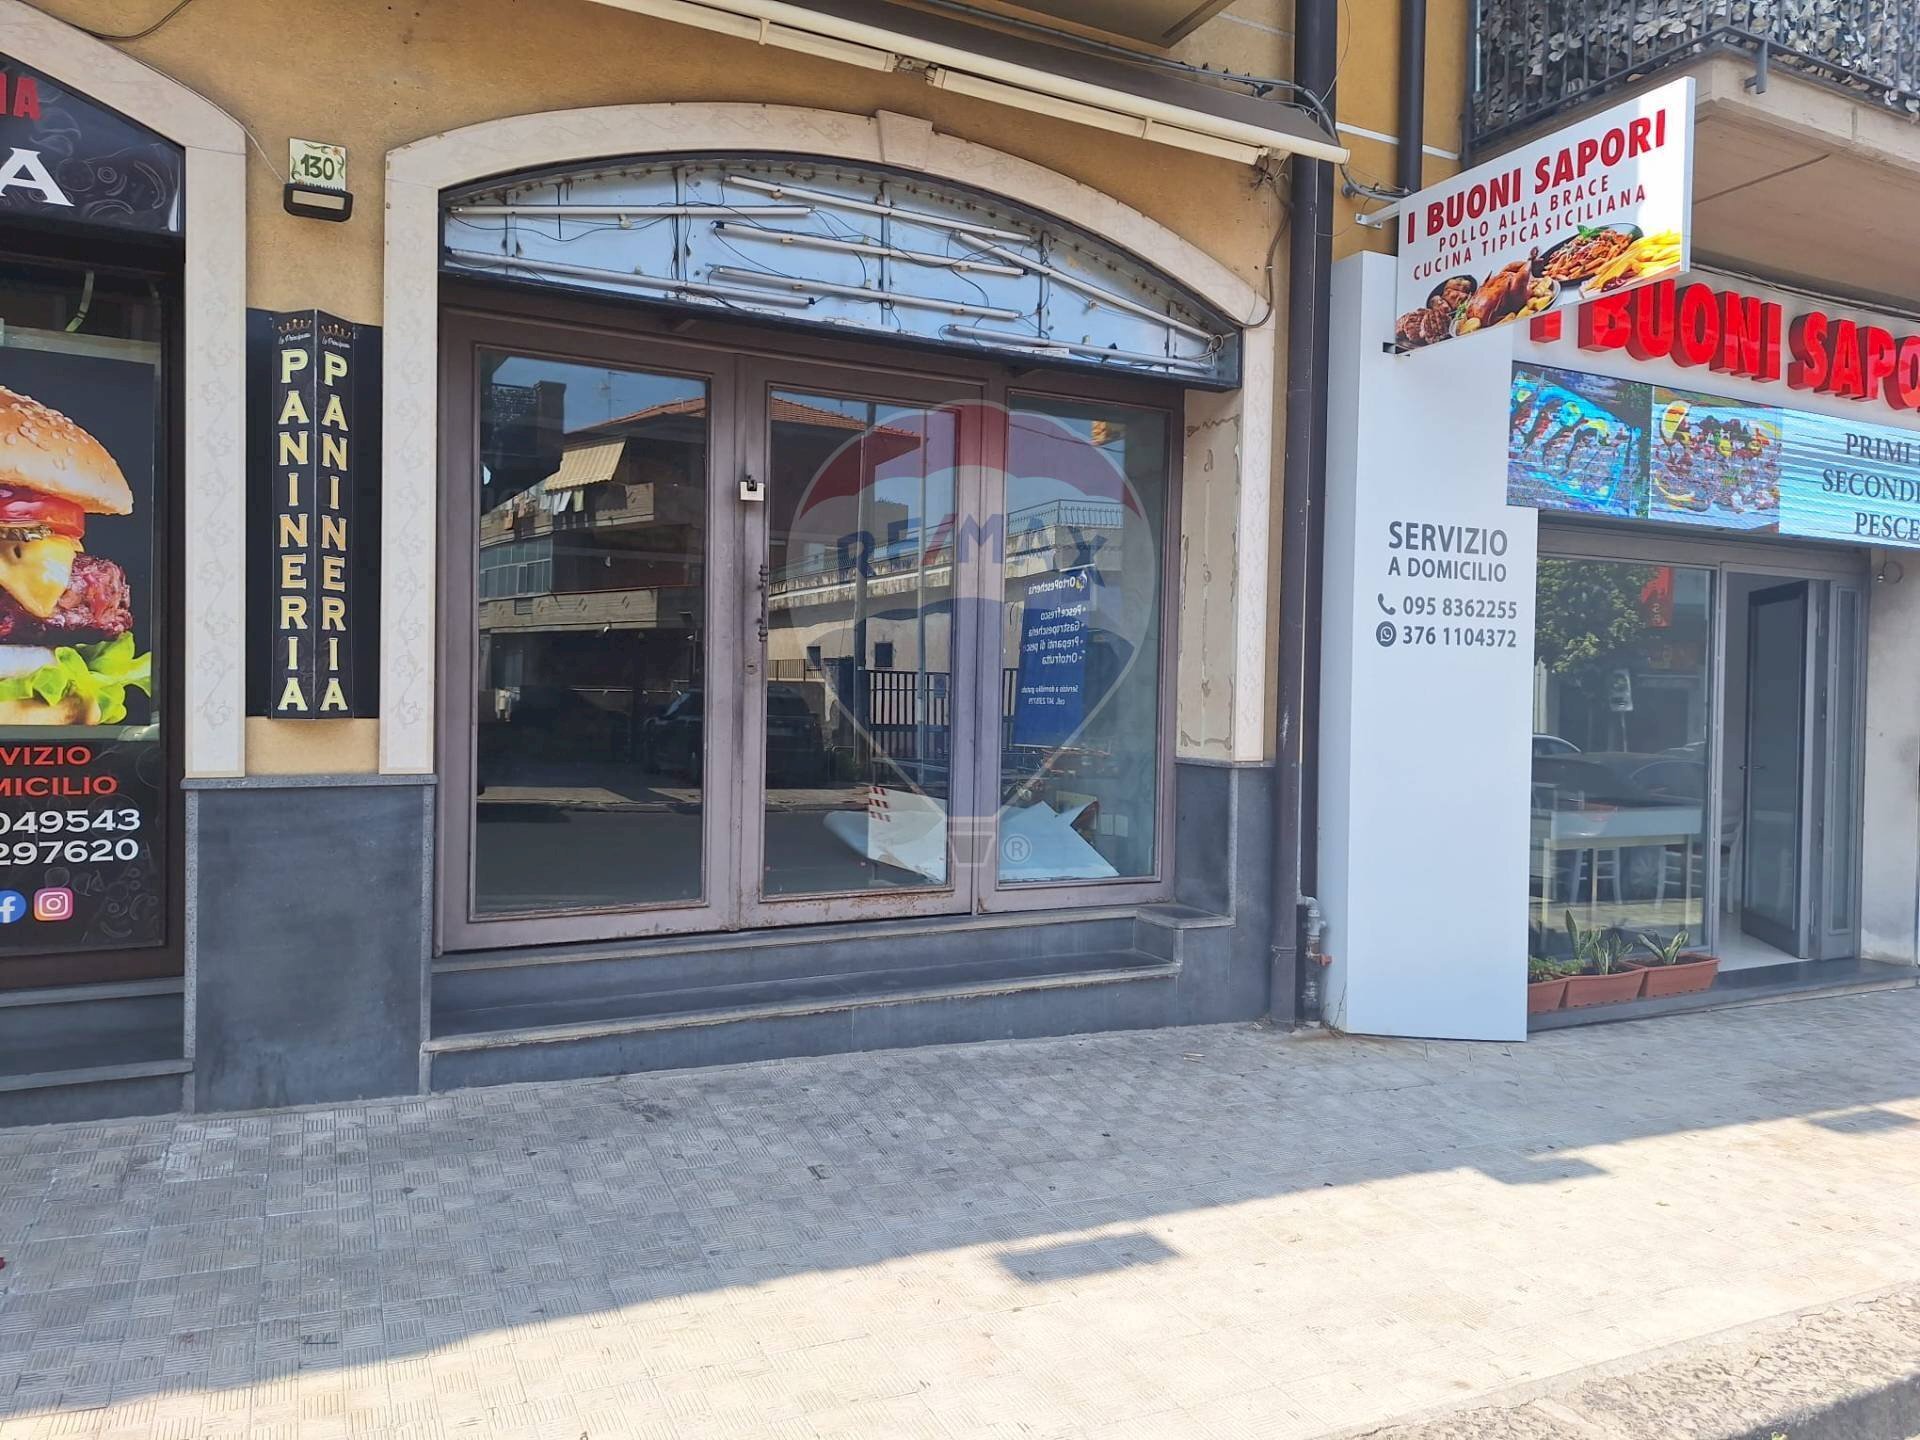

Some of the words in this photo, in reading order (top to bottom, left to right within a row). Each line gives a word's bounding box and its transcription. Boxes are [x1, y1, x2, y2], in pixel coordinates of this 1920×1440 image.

[0, 147, 75, 207] A
[300, 154, 335, 180] 130
[1407, 212, 1416, 244] I
[1427, 168, 1521, 237] BUONI
[1534, 109, 1666, 194] SAPORI
[1439, 222, 1489, 253] POLLO
[1499, 202, 1539, 230] ALLA
[1550, 175, 1609, 212] BRACE
[1413, 247, 1472, 281] CUCINA
[1578, 279, 1782, 383] BUONI
[1845, 432, 1912, 464] PRIMI
[277, 348, 310, 711] PANINERIA
[320, 351, 350, 712] PANINERIA
[1388, 520, 1508, 557] SERVIZIO
[1854, 511, 1920, 541] PESCE
[1387, 556, 1401, 576] A
[1407, 557, 1507, 583] DOMICILIO
[1402, 595, 1436, 616] 095
[1442, 598, 1517, 620] 8362255
[1402, 625, 1437, 645] 376
[1443, 627, 1517, 648] 1104372
